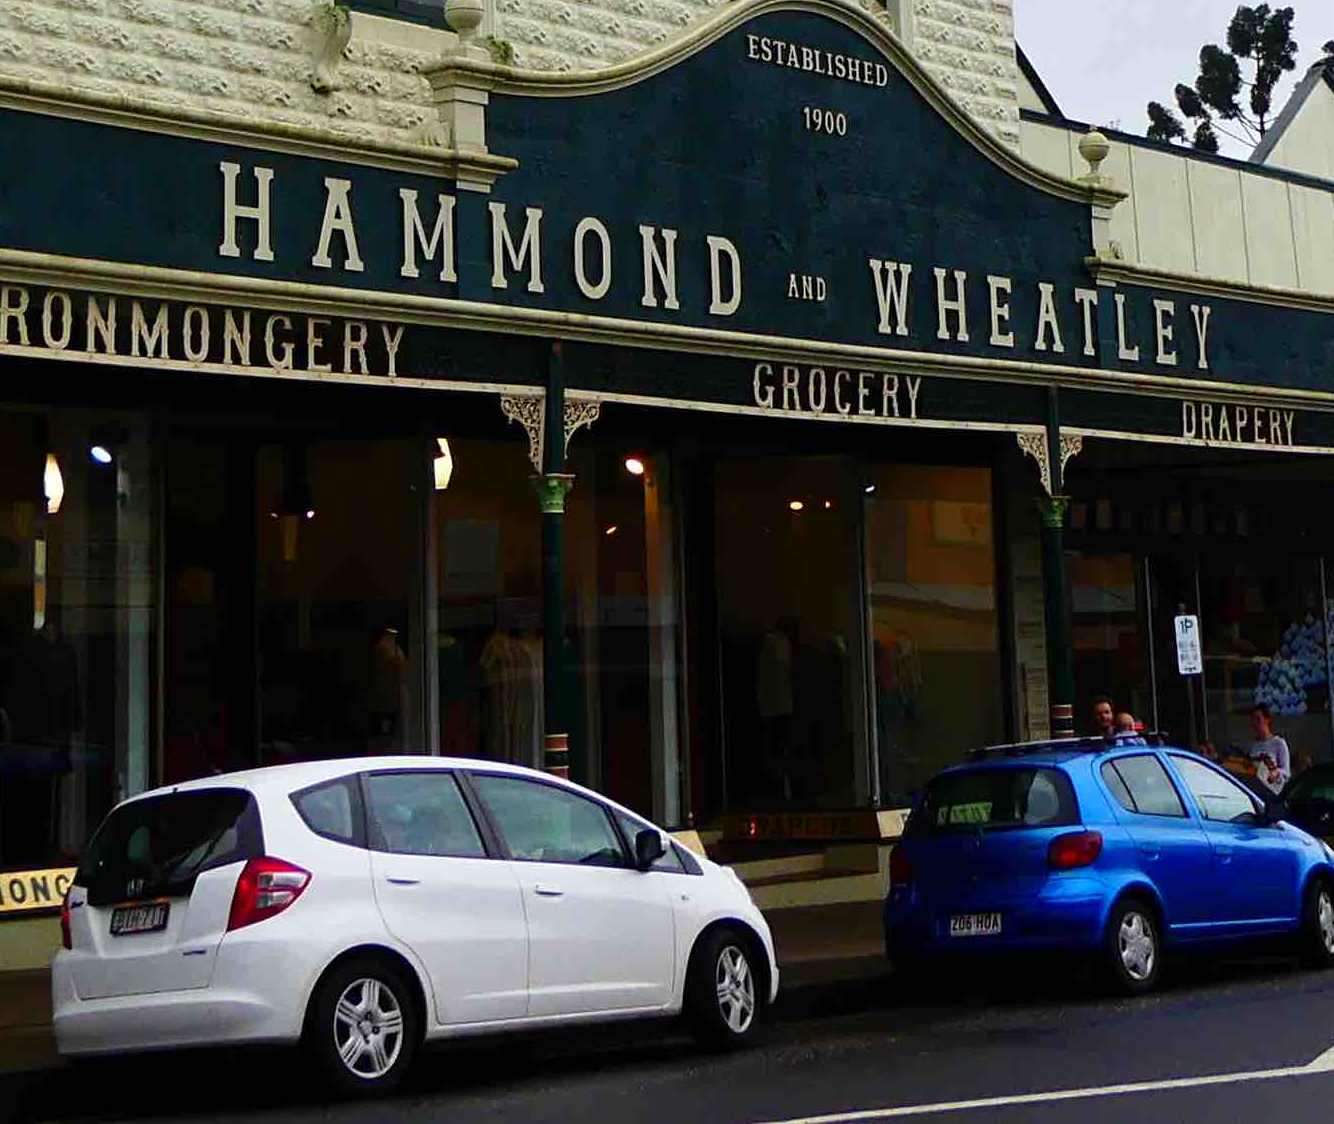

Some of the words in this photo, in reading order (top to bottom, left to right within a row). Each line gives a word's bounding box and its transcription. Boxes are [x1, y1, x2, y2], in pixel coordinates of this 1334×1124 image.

[746, 34, 889, 89] ESTABLISHED
[803, 106, 848, 137] 1900
[218, 161, 743, 316] HAMMOND
[787, 273, 828, 303] AND
[868, 258, 1212, 370] WHEATLEY
[752, 362, 923, 420] GROCERY
[1181, 400, 1296, 447] DRAPERY
